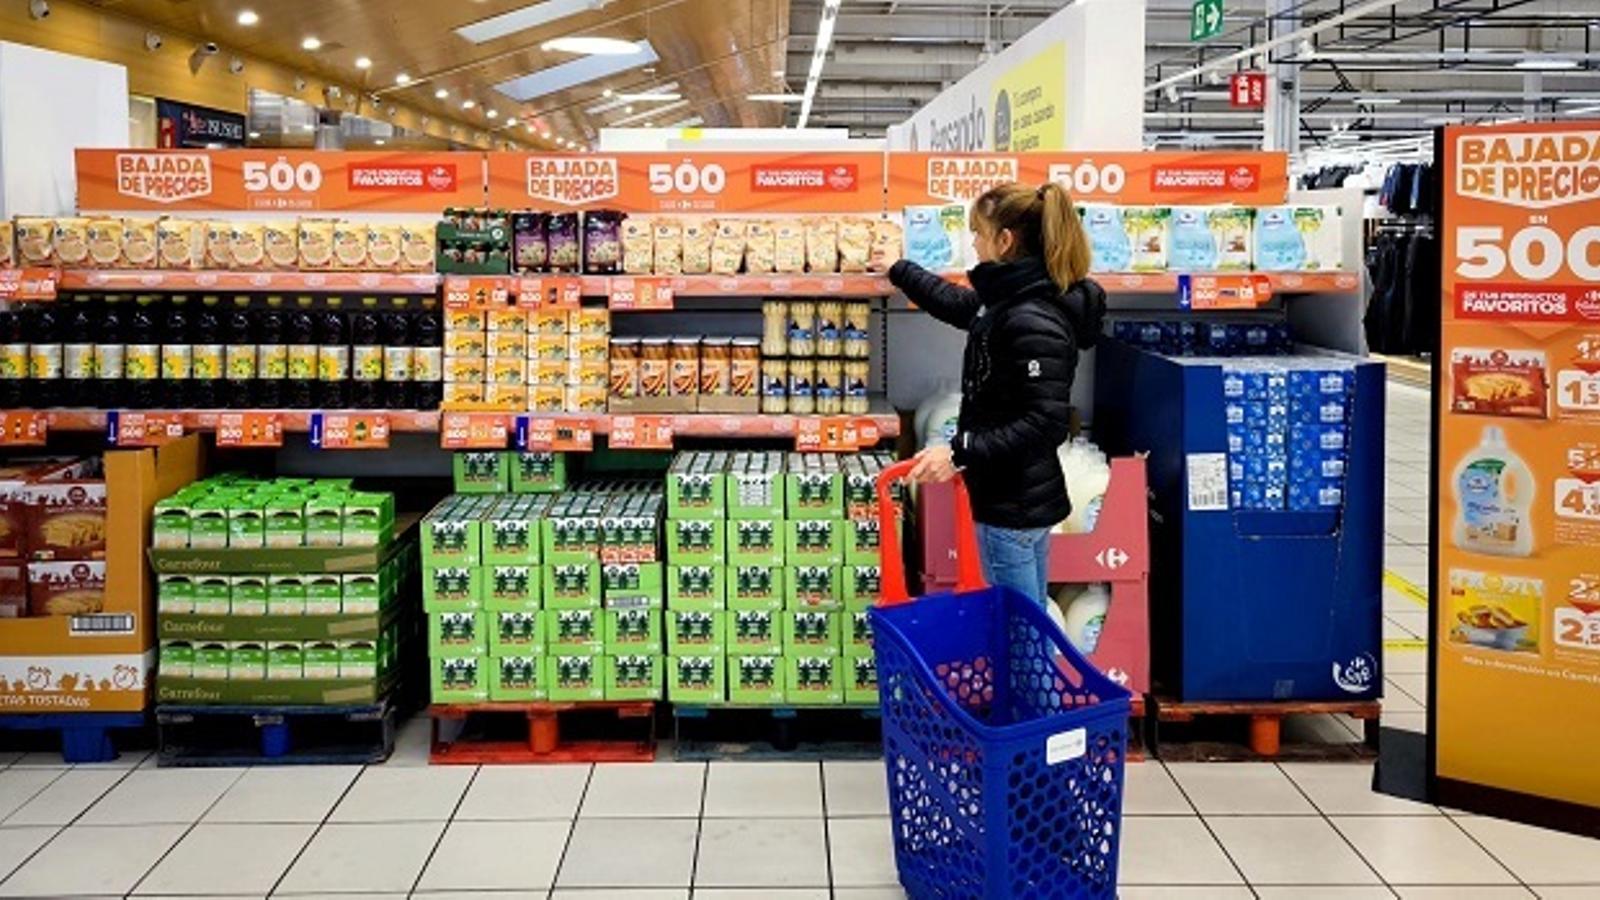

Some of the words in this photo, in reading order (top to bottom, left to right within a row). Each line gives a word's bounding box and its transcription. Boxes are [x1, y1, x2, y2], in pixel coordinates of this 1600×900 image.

[120, 157, 206, 173] BAJADA
[530, 161, 614, 177] BAJADA
[930, 161, 1013, 176] BAJADA
[243, 161, 321, 191] 500
[649, 163, 725, 193] 500
[1048, 163, 1125, 193] 500
[1461, 167, 1496, 195] DE
[121, 177, 142, 193] DE
[145, 176, 209, 197] PRECIOS
[531, 179, 550, 195] DE
[553, 179, 614, 200] PRECIOS
[931, 179, 949, 194] DE
[1529, 215, 1547, 224] EN
[1455, 226, 1600, 282] 500
[1463, 299, 1567, 314] FAVORITOS
[28, 694, 91, 707] TOSTADAS
[160, 687, 221, 700] Carrefour
